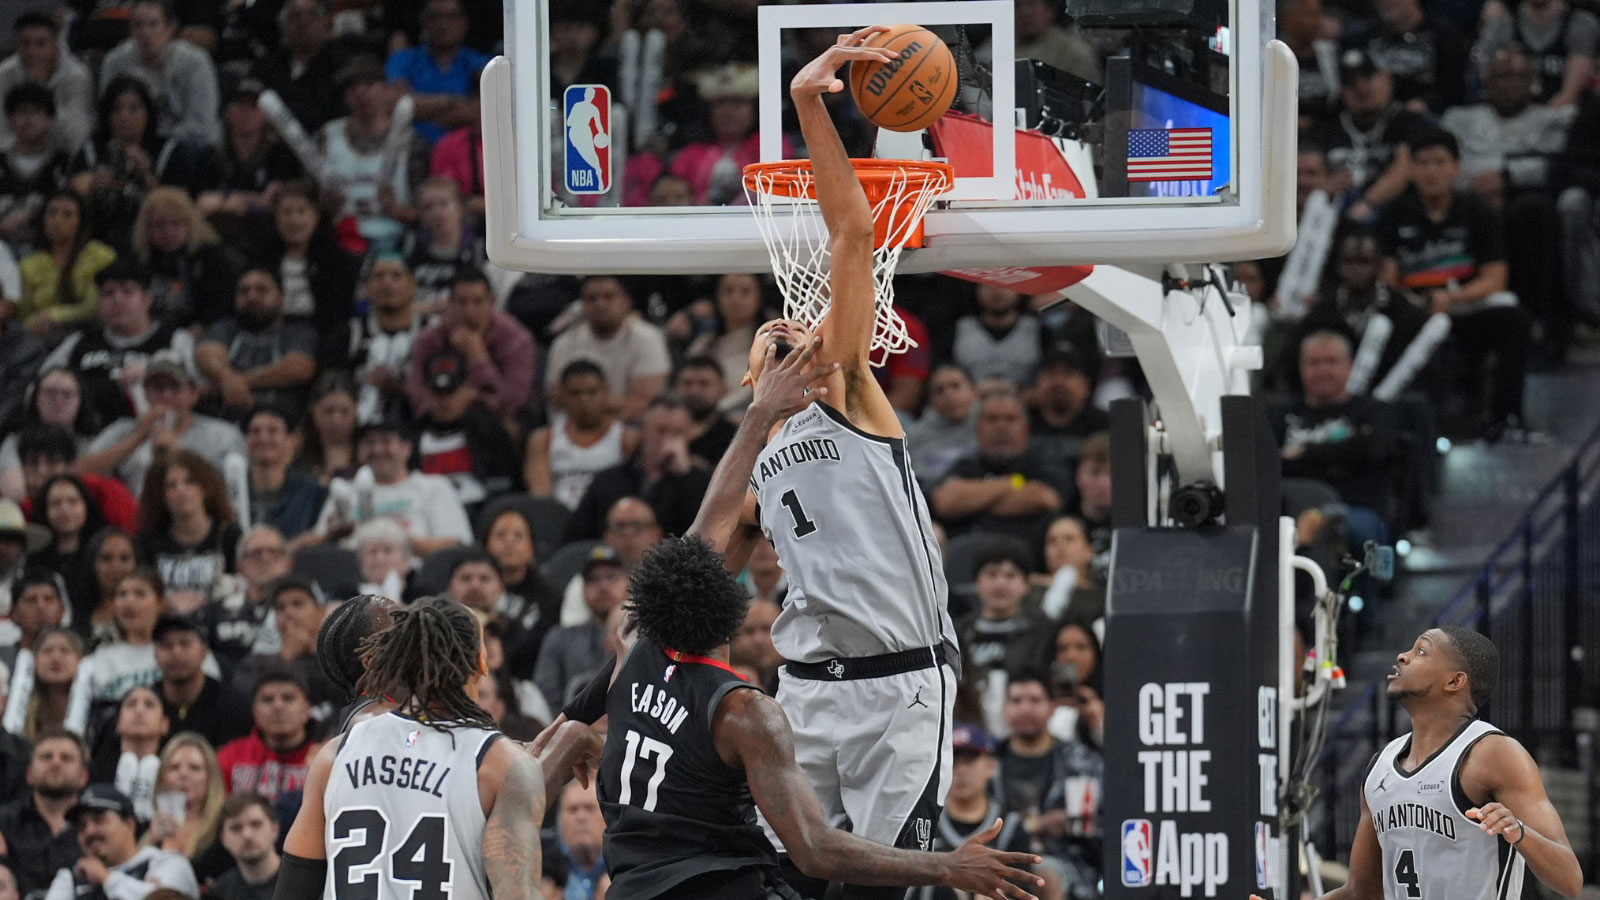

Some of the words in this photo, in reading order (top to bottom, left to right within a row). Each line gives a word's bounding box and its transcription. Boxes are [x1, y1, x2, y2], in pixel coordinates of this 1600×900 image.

[866, 41, 923, 96] Wilson
[571, 169, 594, 187] NBA
[794, 412, 817, 428] LEDGER
[760, 439, 841, 483] ANTONIO
[780, 489, 818, 539] 1
[631, 682, 689, 735] EASON
[1138, 682, 1210, 745] GET
[345, 755, 451, 798] VASSELL
[619, 729, 674, 812] 17
[1138, 750, 1211, 813] THE
[1420, 783, 1441, 791] LEDGER
[1388, 803, 1456, 840] ANTONIO
[331, 806, 456, 900] 24
[1155, 820, 1229, 898] App
[1394, 849, 1422, 899] 4
